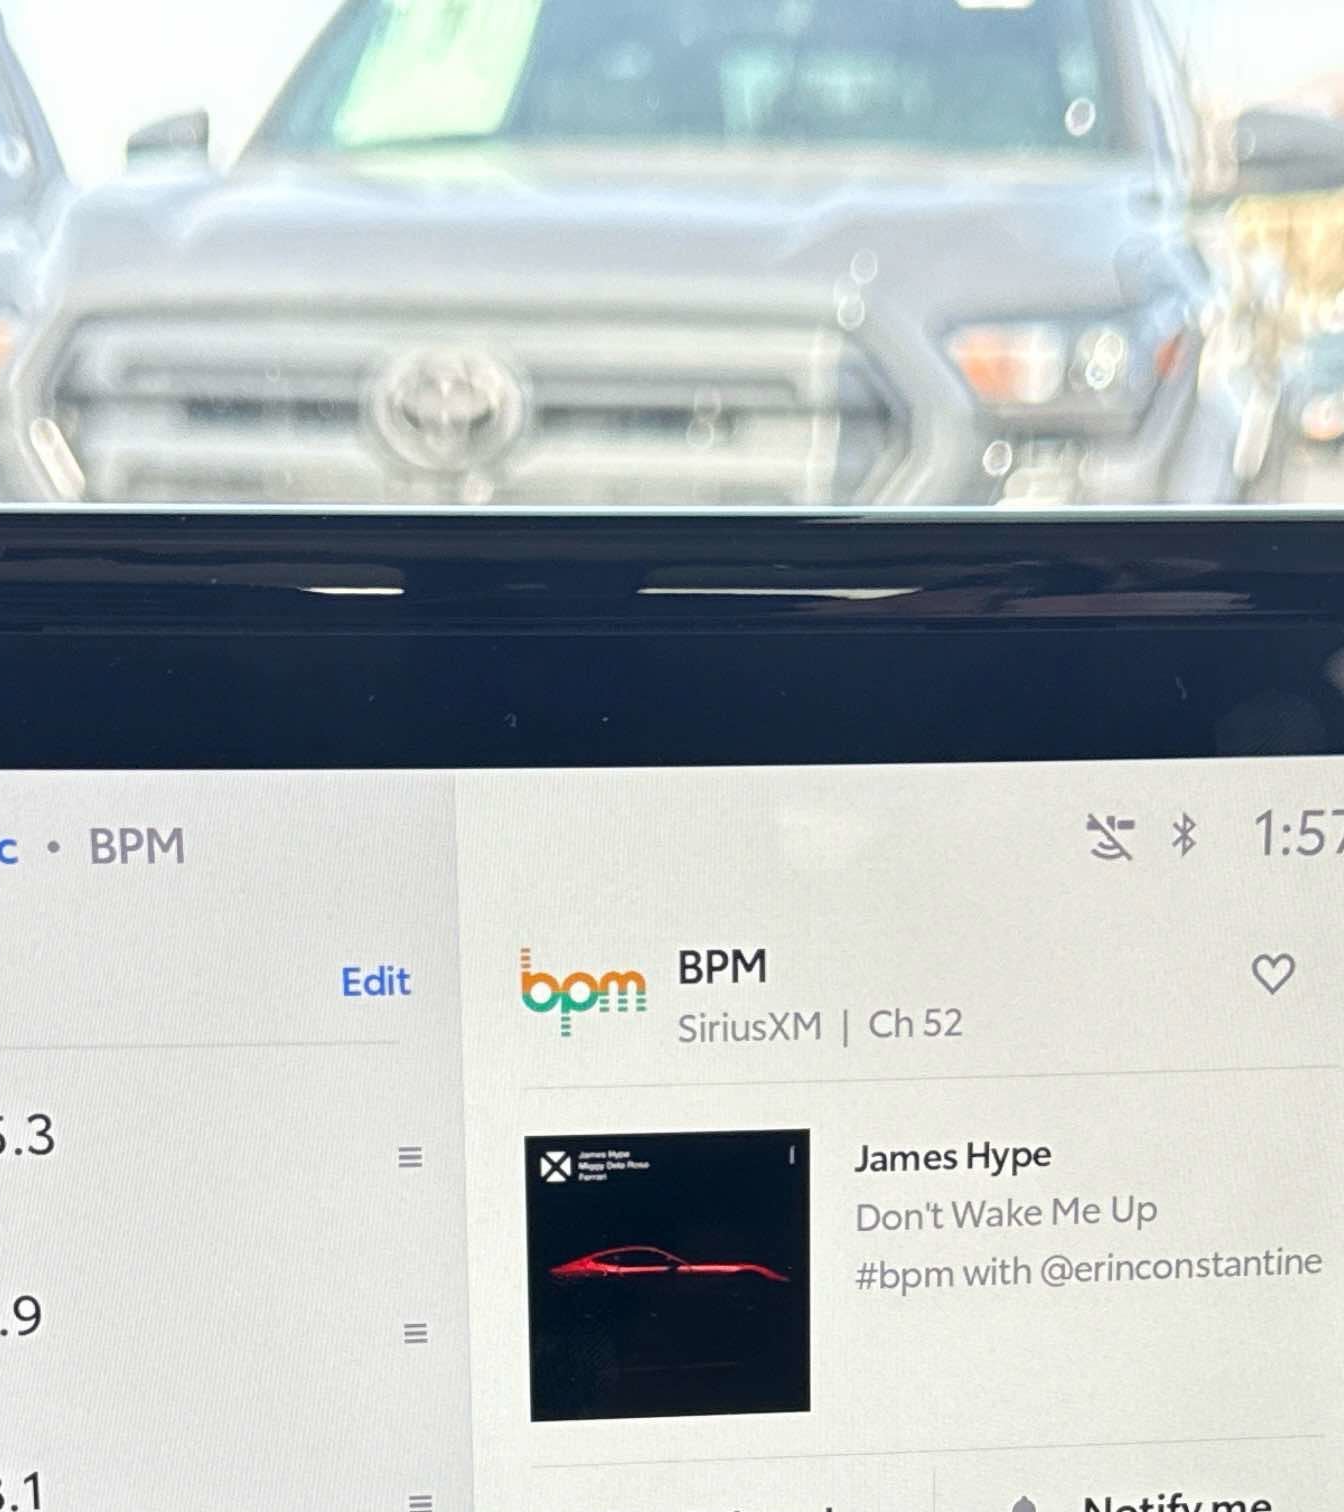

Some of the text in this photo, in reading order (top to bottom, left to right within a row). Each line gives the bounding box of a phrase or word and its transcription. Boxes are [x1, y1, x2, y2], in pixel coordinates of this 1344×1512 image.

[89, 827, 185, 865] BPM
[342, 965, 412, 997] Edit
[680, 948, 768, 985] BPM
[520, 947, 647, 1038] bpm
[678, 1011, 822, 1044] SiriusXM
[869, 1008, 915, 1039] Ch
[923, 1007, 964, 1038] 52
[855, 1141, 1052, 1178] James Hype
[856, 1196, 1158, 1232] Don't Wake Me Up
[856, 1249, 1324, 1297] #bpm with @erinconstantine
